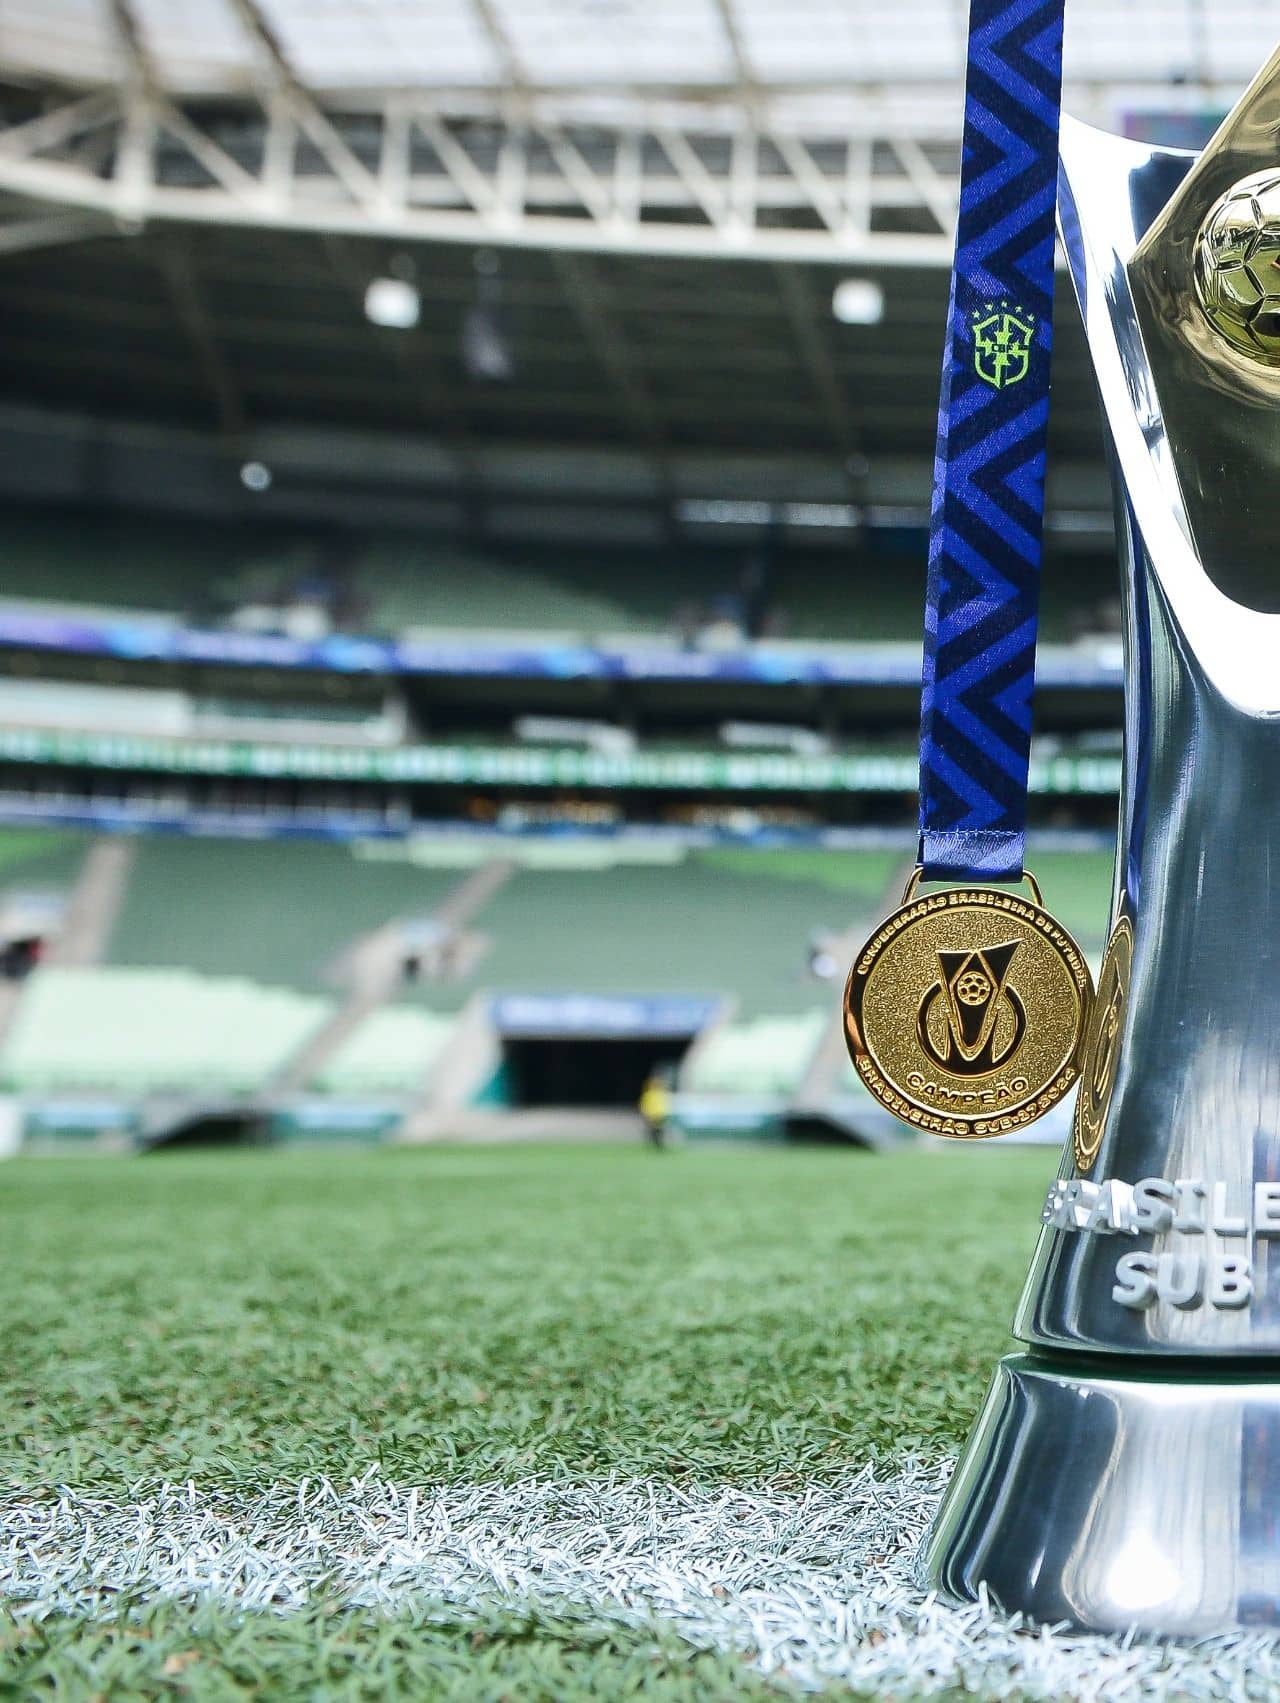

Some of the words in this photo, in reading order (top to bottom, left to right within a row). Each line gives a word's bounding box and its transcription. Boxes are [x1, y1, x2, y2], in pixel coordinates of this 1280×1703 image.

[857, 896, 947, 975] CONFEDERAÇÃO
[949, 892, 1035, 921] BRASILEIRA
[1035, 917, 1053, 933] DE
[1051, 931, 1087, 988] FUTEBOL
[856, 1055, 969, 1135] BRASILEIRÃO
[1038, 1067, 1075, 1108] 2024
[906, 1071, 1029, 1104] CAMPEÃO
[1112, 1251, 1256, 1311] SUB
